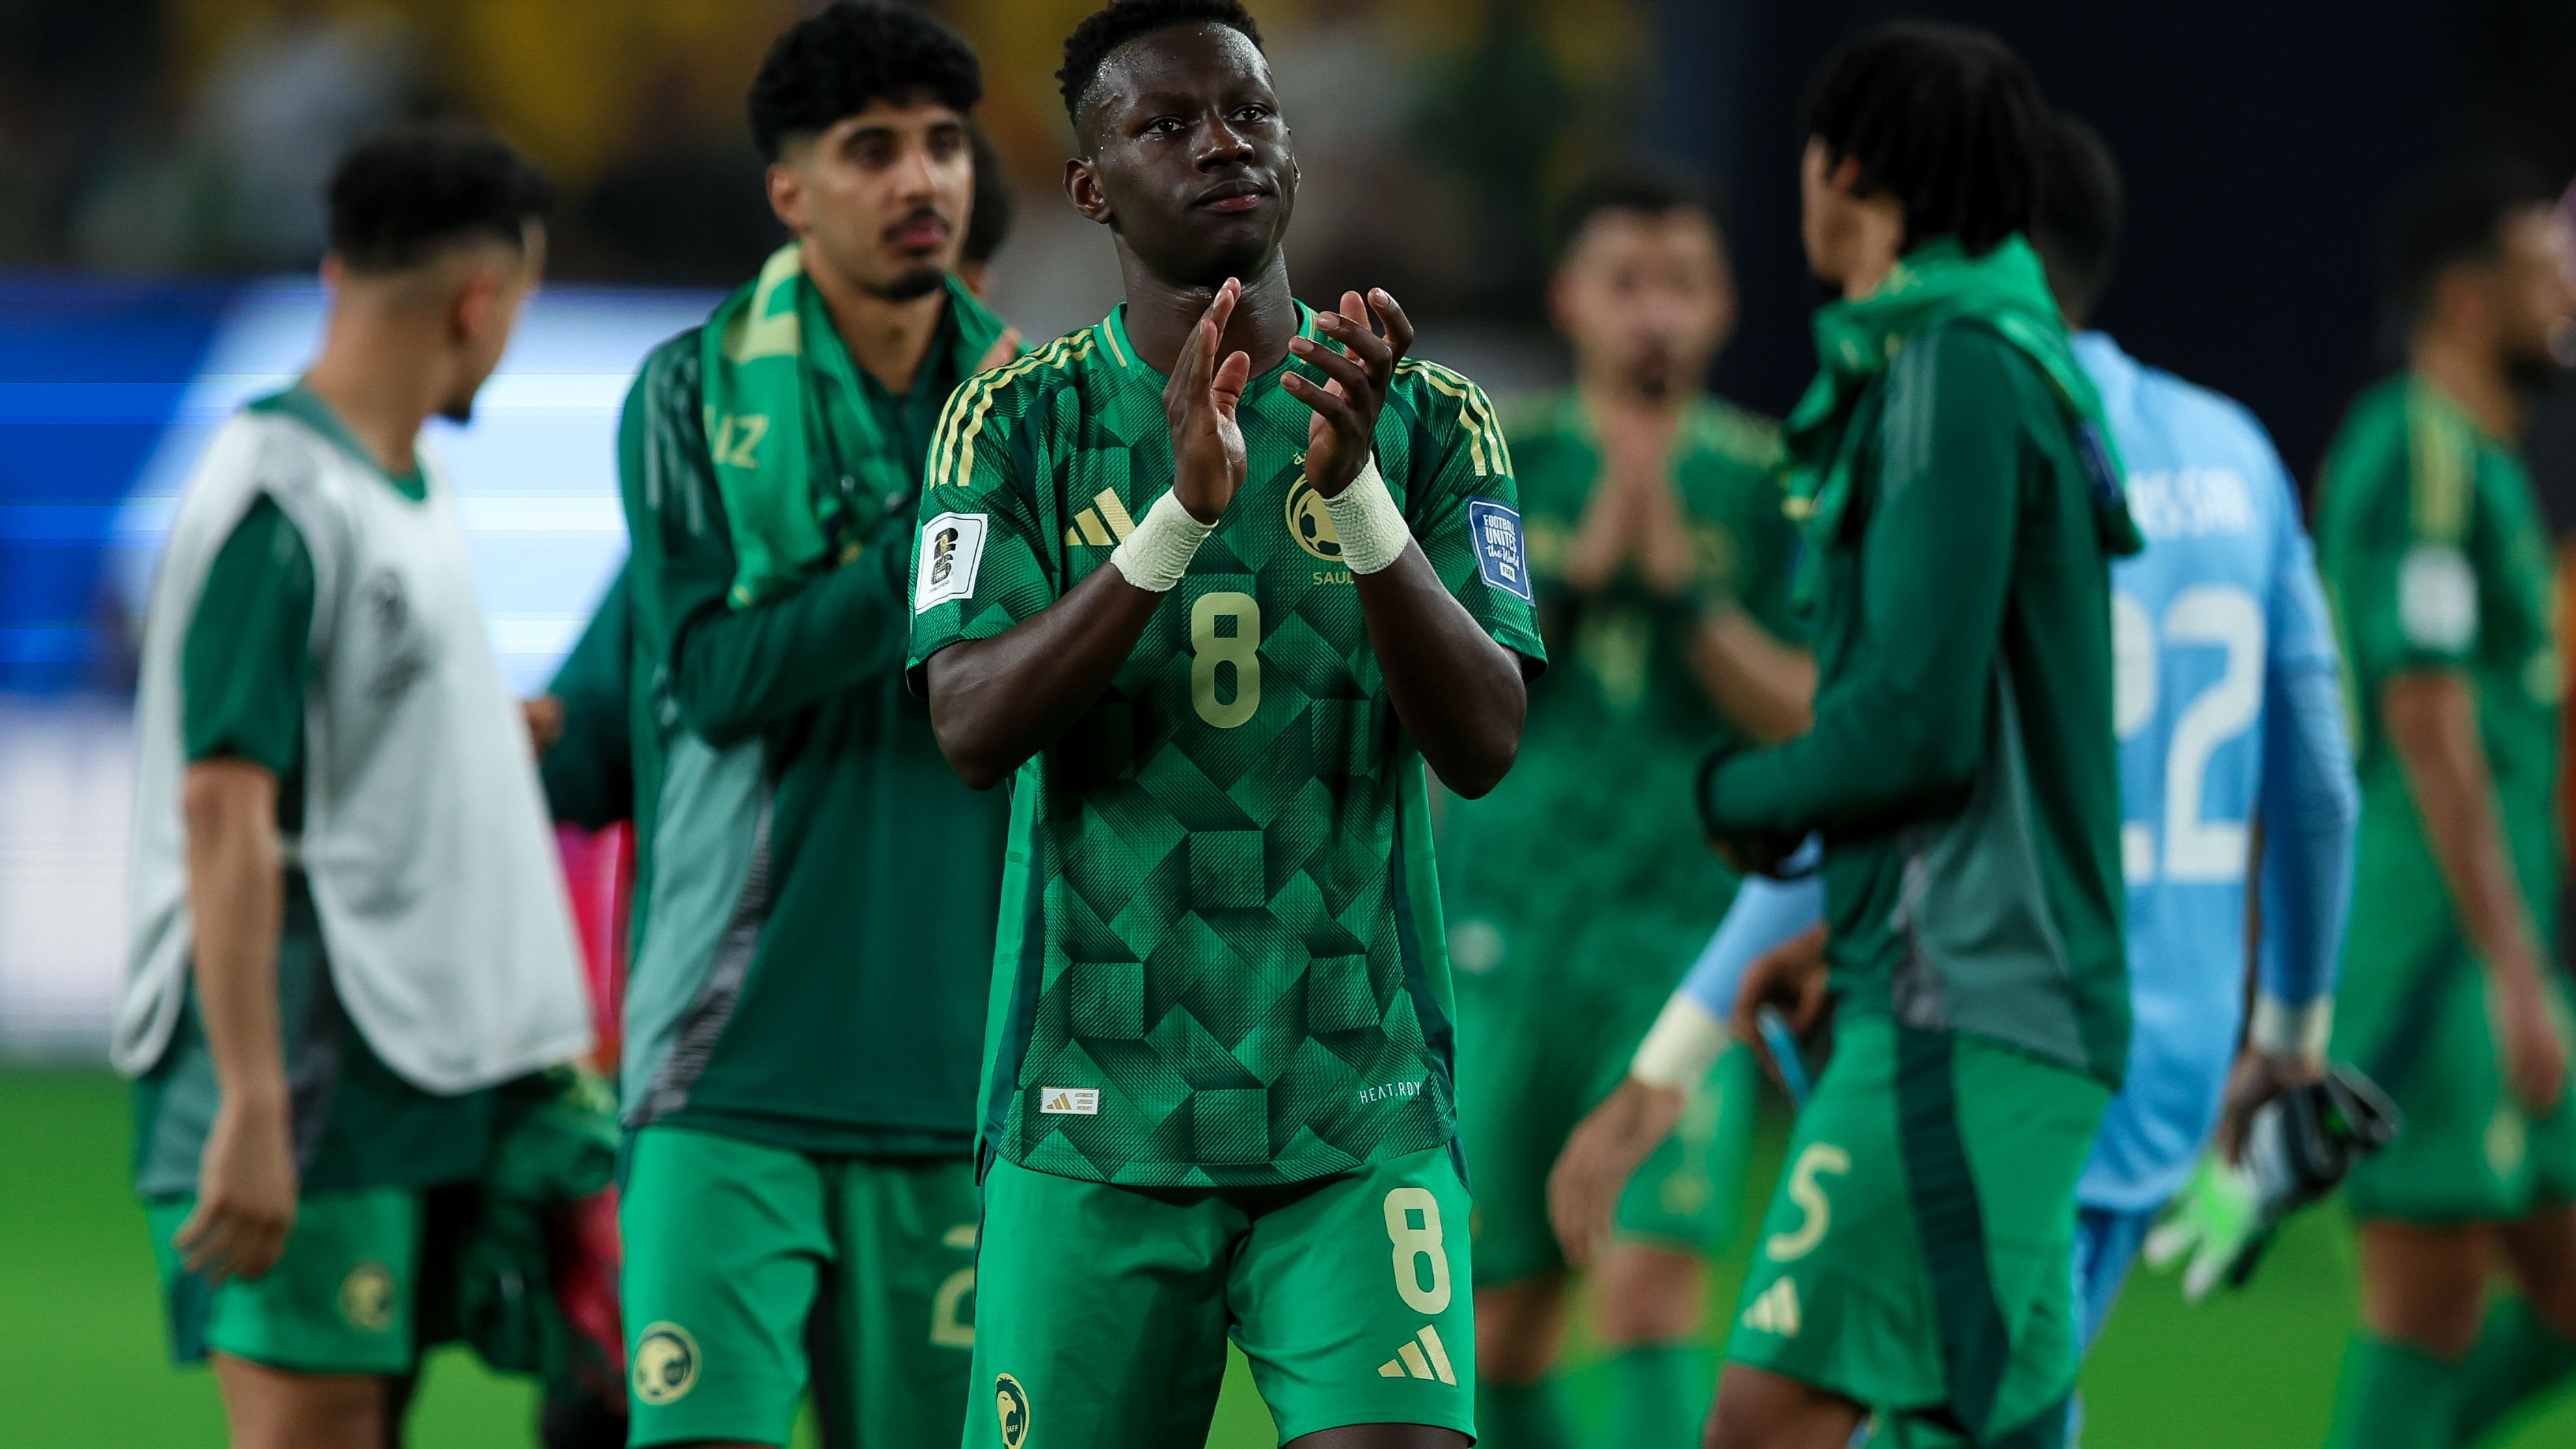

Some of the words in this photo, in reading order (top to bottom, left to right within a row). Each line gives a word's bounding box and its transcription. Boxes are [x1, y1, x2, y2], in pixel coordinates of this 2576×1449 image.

[1483, 515, 1515, 536] FOOTBALL
[1485, 527, 1517, 553] UNITES
[1485, 545, 1503, 558] the
[1502, 566, 1513, 578] FIFA
[1191, 592, 1260, 729] 8
[1359, 1082, 1420, 1104] HEAT.RDY
[1766, 1141, 1850, 1262] 5
[1383, 1187, 1451, 1314] 8
[1007, 1424, 1018, 1433] SAFF
